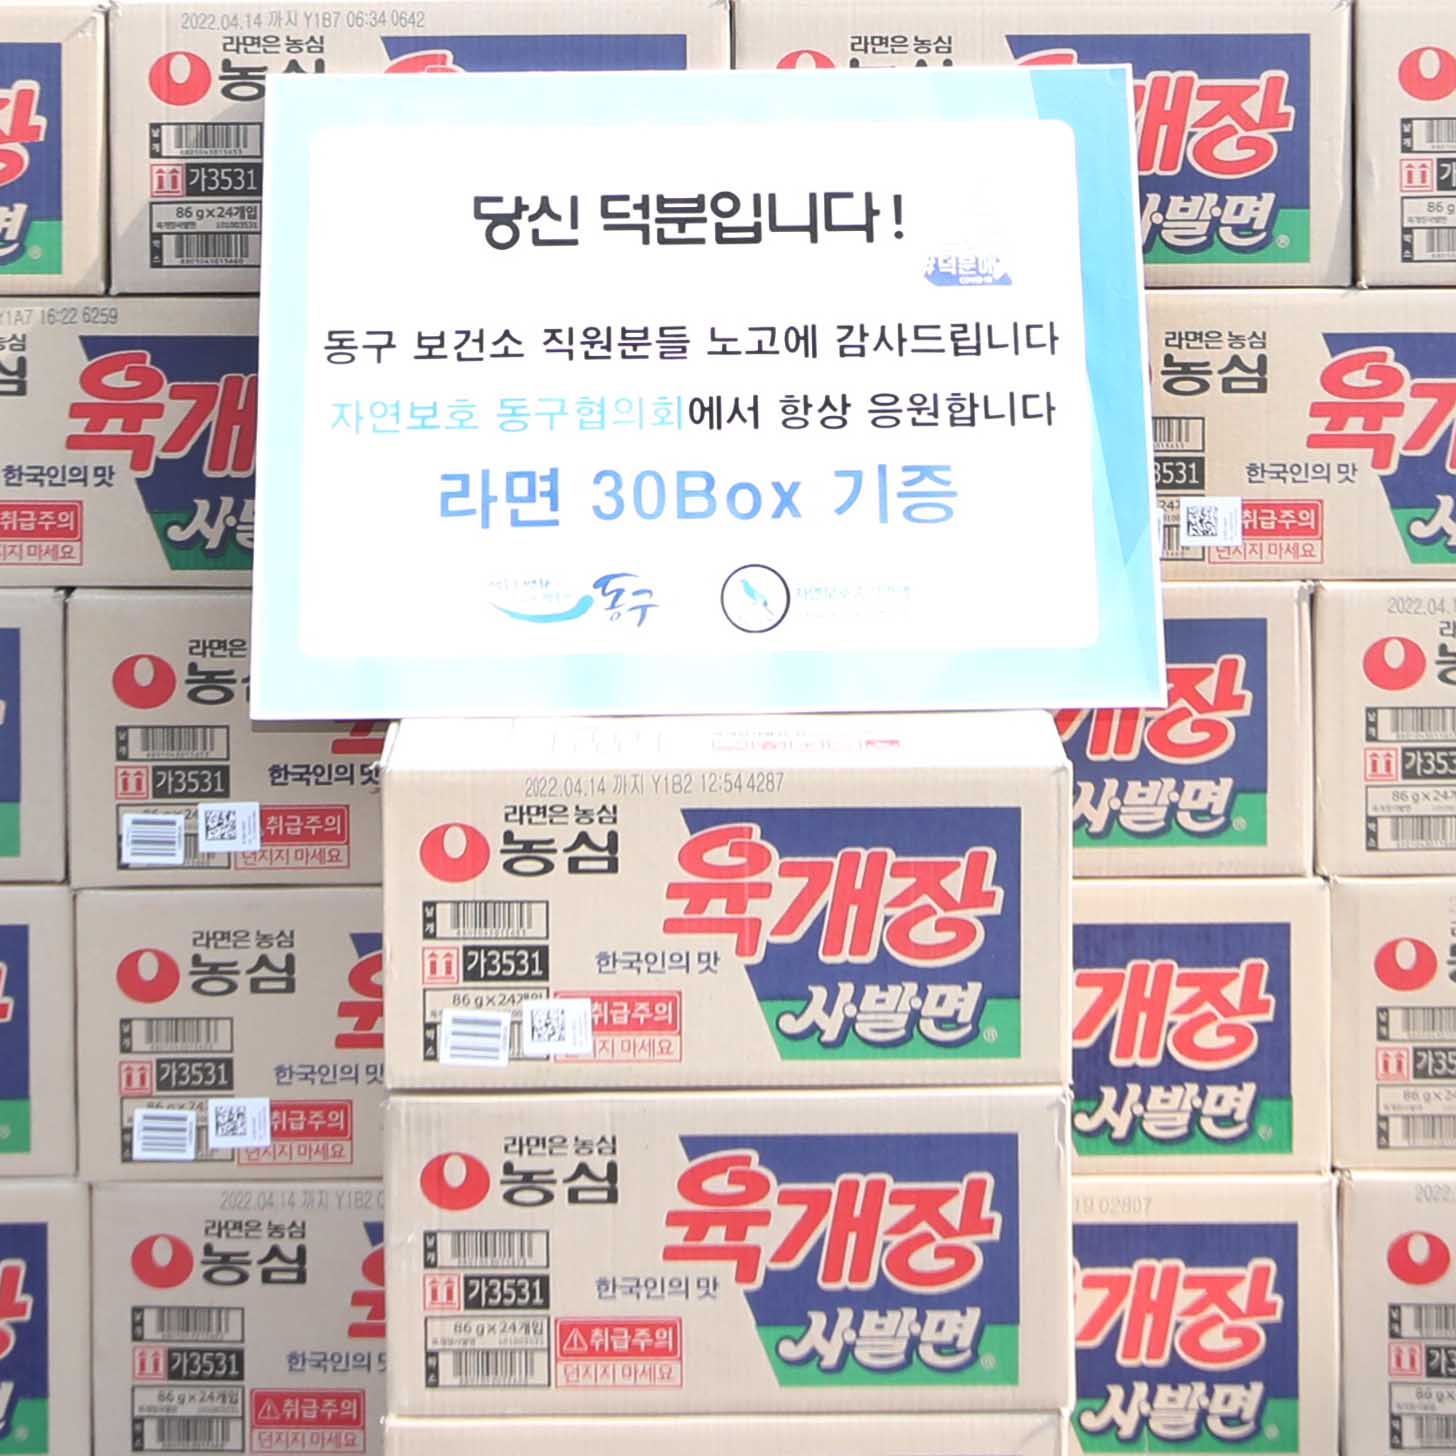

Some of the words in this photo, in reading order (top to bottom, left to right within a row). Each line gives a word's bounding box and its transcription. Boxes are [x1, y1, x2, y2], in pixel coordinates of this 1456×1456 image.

[181, 12, 262, 31] 2022.04.14
[347, 10, 387, 28] 06:34
[391, 10, 425, 28] 0642
[222, 34, 280, 54] 라면은
[284, 34, 324, 53] 농심
[850, 34, 908, 53] 라면은
[913, 35, 953, 53] 농심
[1133, 71, 1294, 178] 개장
[188, 166, 258, 192] 가3531
[176, 205, 192, 219] 86
[475, 197, 579, 251] 당신
[602, 193, 904, 246] 덕분입니다!
[1142, 193, 1276, 247] 발면
[1427, 200, 1443, 214] 86
[40, 307, 78, 325] 16:22
[82, 306, 119, 325] 6259
[326, 332, 397, 365] 동구
[415, 330, 525, 362] 보건소
[545, 327, 691, 361] 직원분들
[709, 326, 818, 359] 노고에
[838, 323, 1059, 358] 감사드립니다
[1160, 353, 1268, 397] 농심
[64, 349, 257, 479] 육개
[329, 396, 480, 435] 자연보호
[496, 394, 760, 433] 동구협의회에서
[781, 395, 852, 430] 항상
[870, 393, 1056, 429] 응원합니다
[1154, 461, 1201, 485] 3531
[1245, 460, 1331, 482] 한국인의
[1336, 461, 1357, 483] 맛
[441, 468, 560, 529] 라면
[595, 471, 801, 521] 30Box
[837, 465, 958, 524] 기증
[0, 511, 75, 532] 취급주의
[184, 661, 250, 706] 농
[525, 776, 606, 797] 2022.04.14
[612, 774, 644, 795] 까지
[701, 773, 742, 793] 12:54
[746, 772, 784, 793] 4287
[1073, 777, 1233, 835] 사발면
[499, 829, 619, 878] 농심
[661, 821, 1001, 965] 육개장
[188, 953, 296, 998] 농심
[466, 949, 544, 978] 가3531
[777, 980, 986, 1047] 사발면
[1073, 958, 1275, 1071] 개장
[1072, 1082, 1257, 1143] 사발면
[504, 1134, 568, 1156] 라면은
[574, 1134, 618, 1155] 농심
[500, 1160, 618, 1207] 농심
[661, 1152, 998, 1291] 육개장
[200, 1243, 308, 1287] 농심
[467, 1278, 544, 1305] 가3531
[594, 1276, 689, 1299] 한국인의
[695, 1276, 718, 1299] 맛
[453, 1320, 471, 1336] 86
[1074, 1257, 1284, 1371] 개장
[589, 1329, 674, 1352] 취급주의
[776, 1307, 985, 1372] 사발면
[563, 1366, 615, 1385] 던지지
[622, 1366, 675, 1384] 마세요
[1080, 1383, 1265, 1442] 사발면
